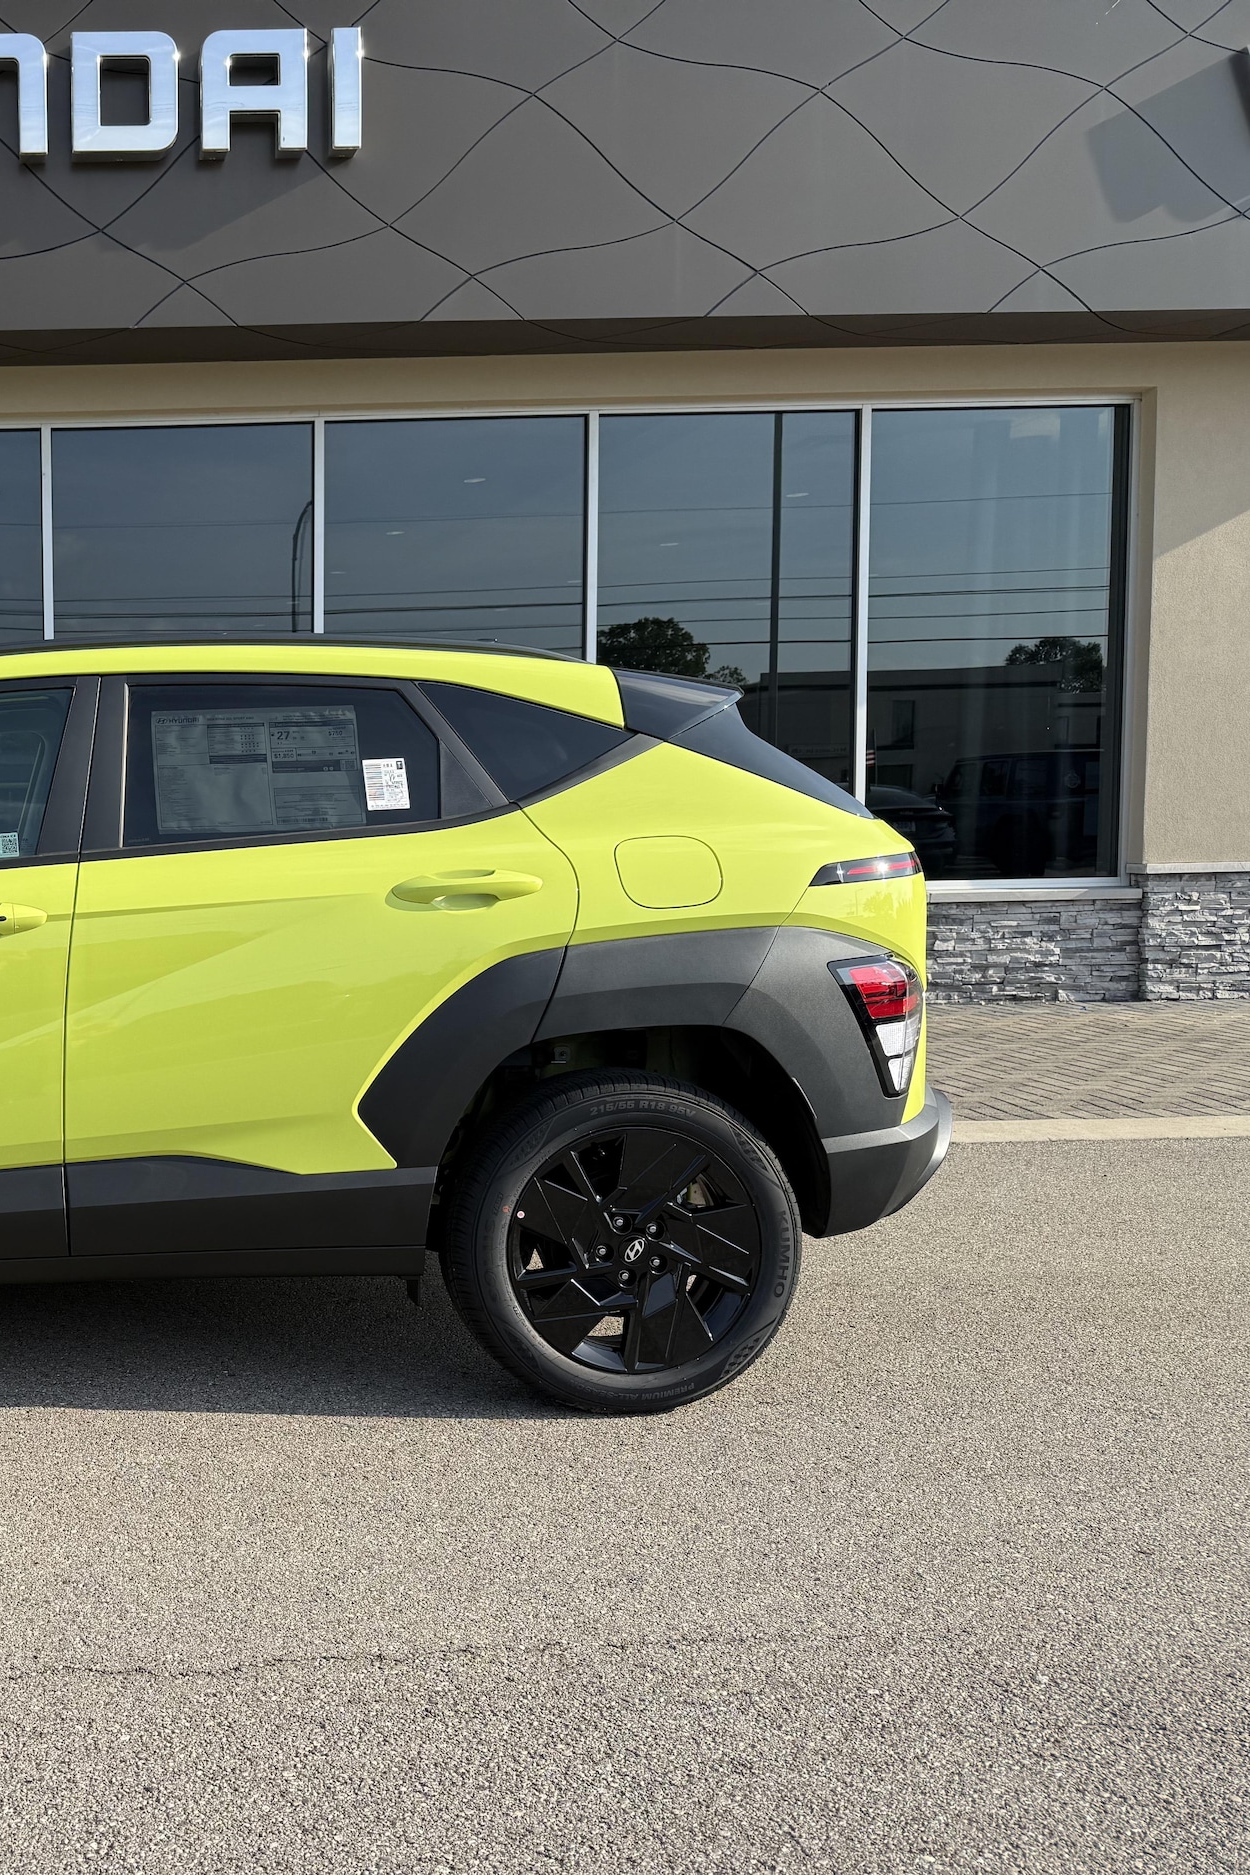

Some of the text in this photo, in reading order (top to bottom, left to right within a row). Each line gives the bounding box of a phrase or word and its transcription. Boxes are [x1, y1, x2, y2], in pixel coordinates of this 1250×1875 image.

[276, 730, 290, 741] 27
[589, 1100, 696, 1117] 215/55 R18 95V
[774, 1209, 793, 1298] KUMHO
[641, 1382, 696, 1401] PREMIUM
